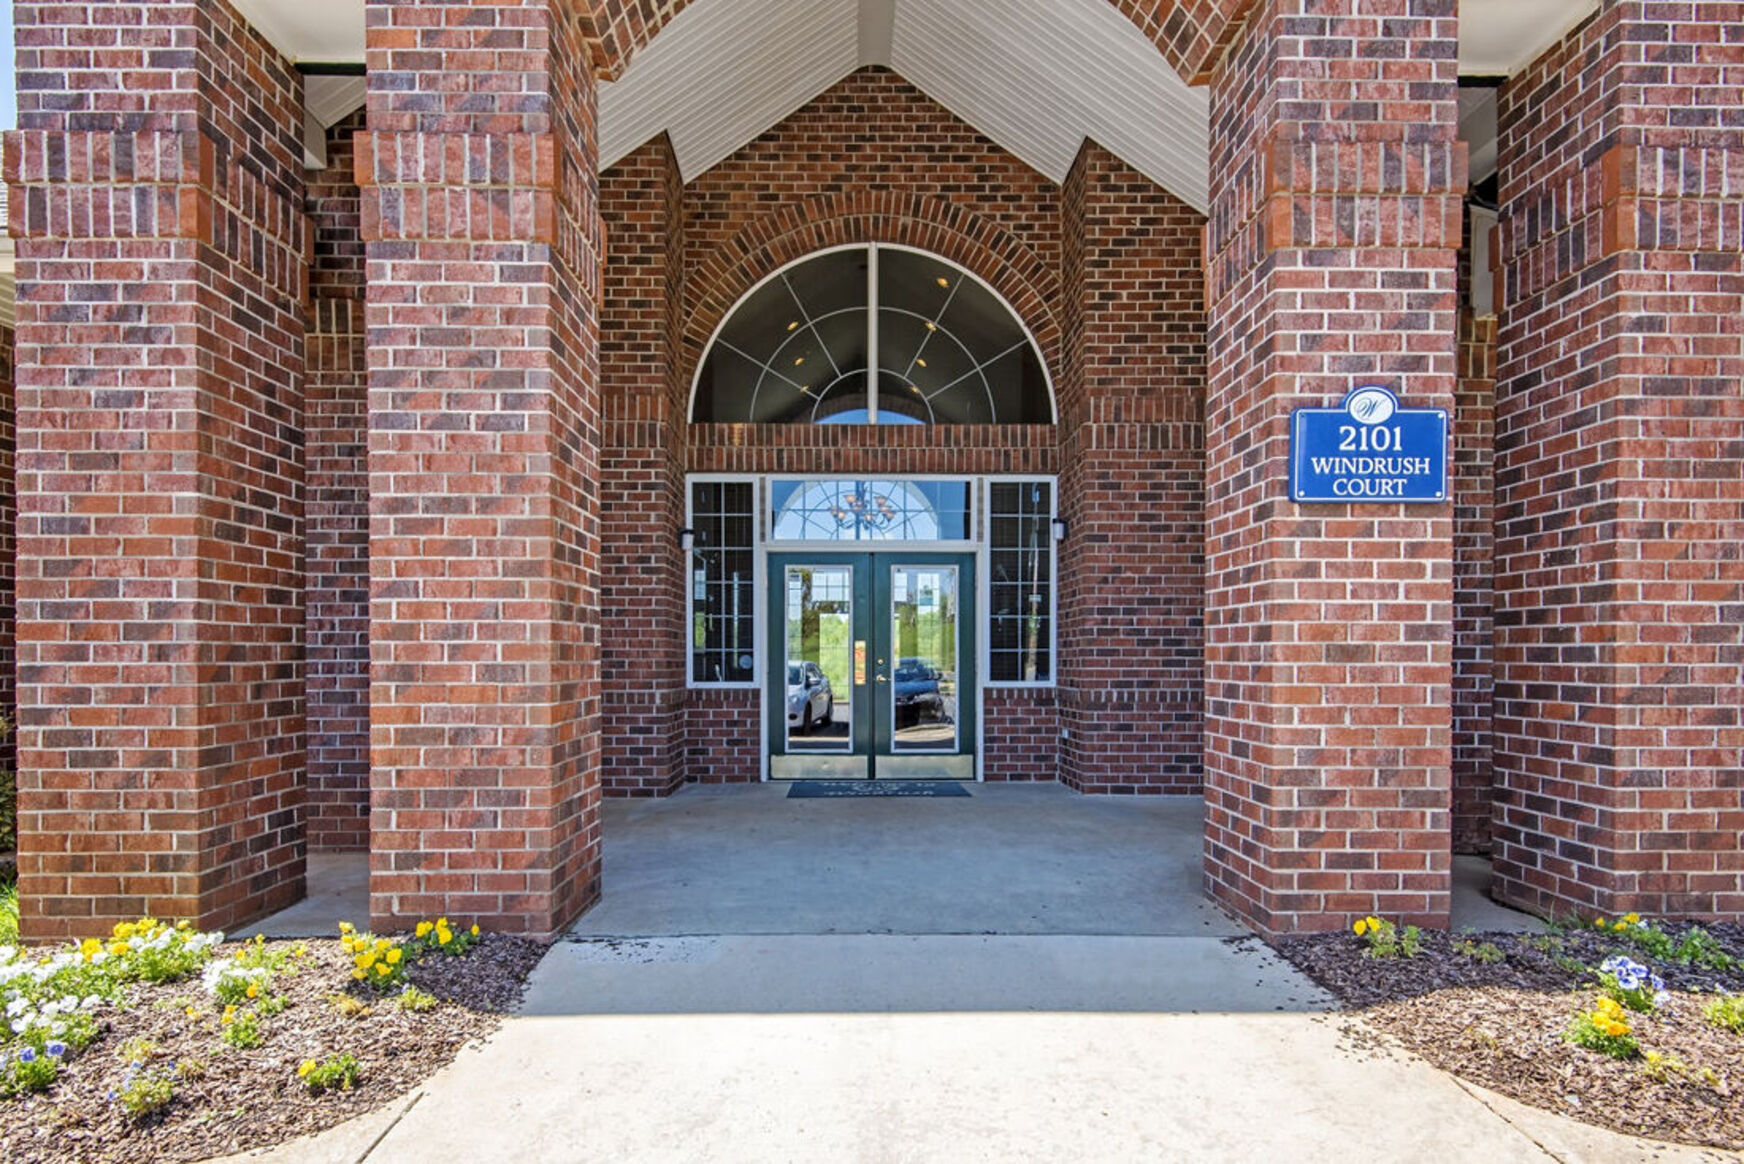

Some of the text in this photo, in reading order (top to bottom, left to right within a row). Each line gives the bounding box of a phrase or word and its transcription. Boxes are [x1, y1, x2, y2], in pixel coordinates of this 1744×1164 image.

[1338, 425, 1403, 451] 2101
[1311, 457, 1431, 475] WINDRUSH
[1332, 478, 1408, 496] COURT
